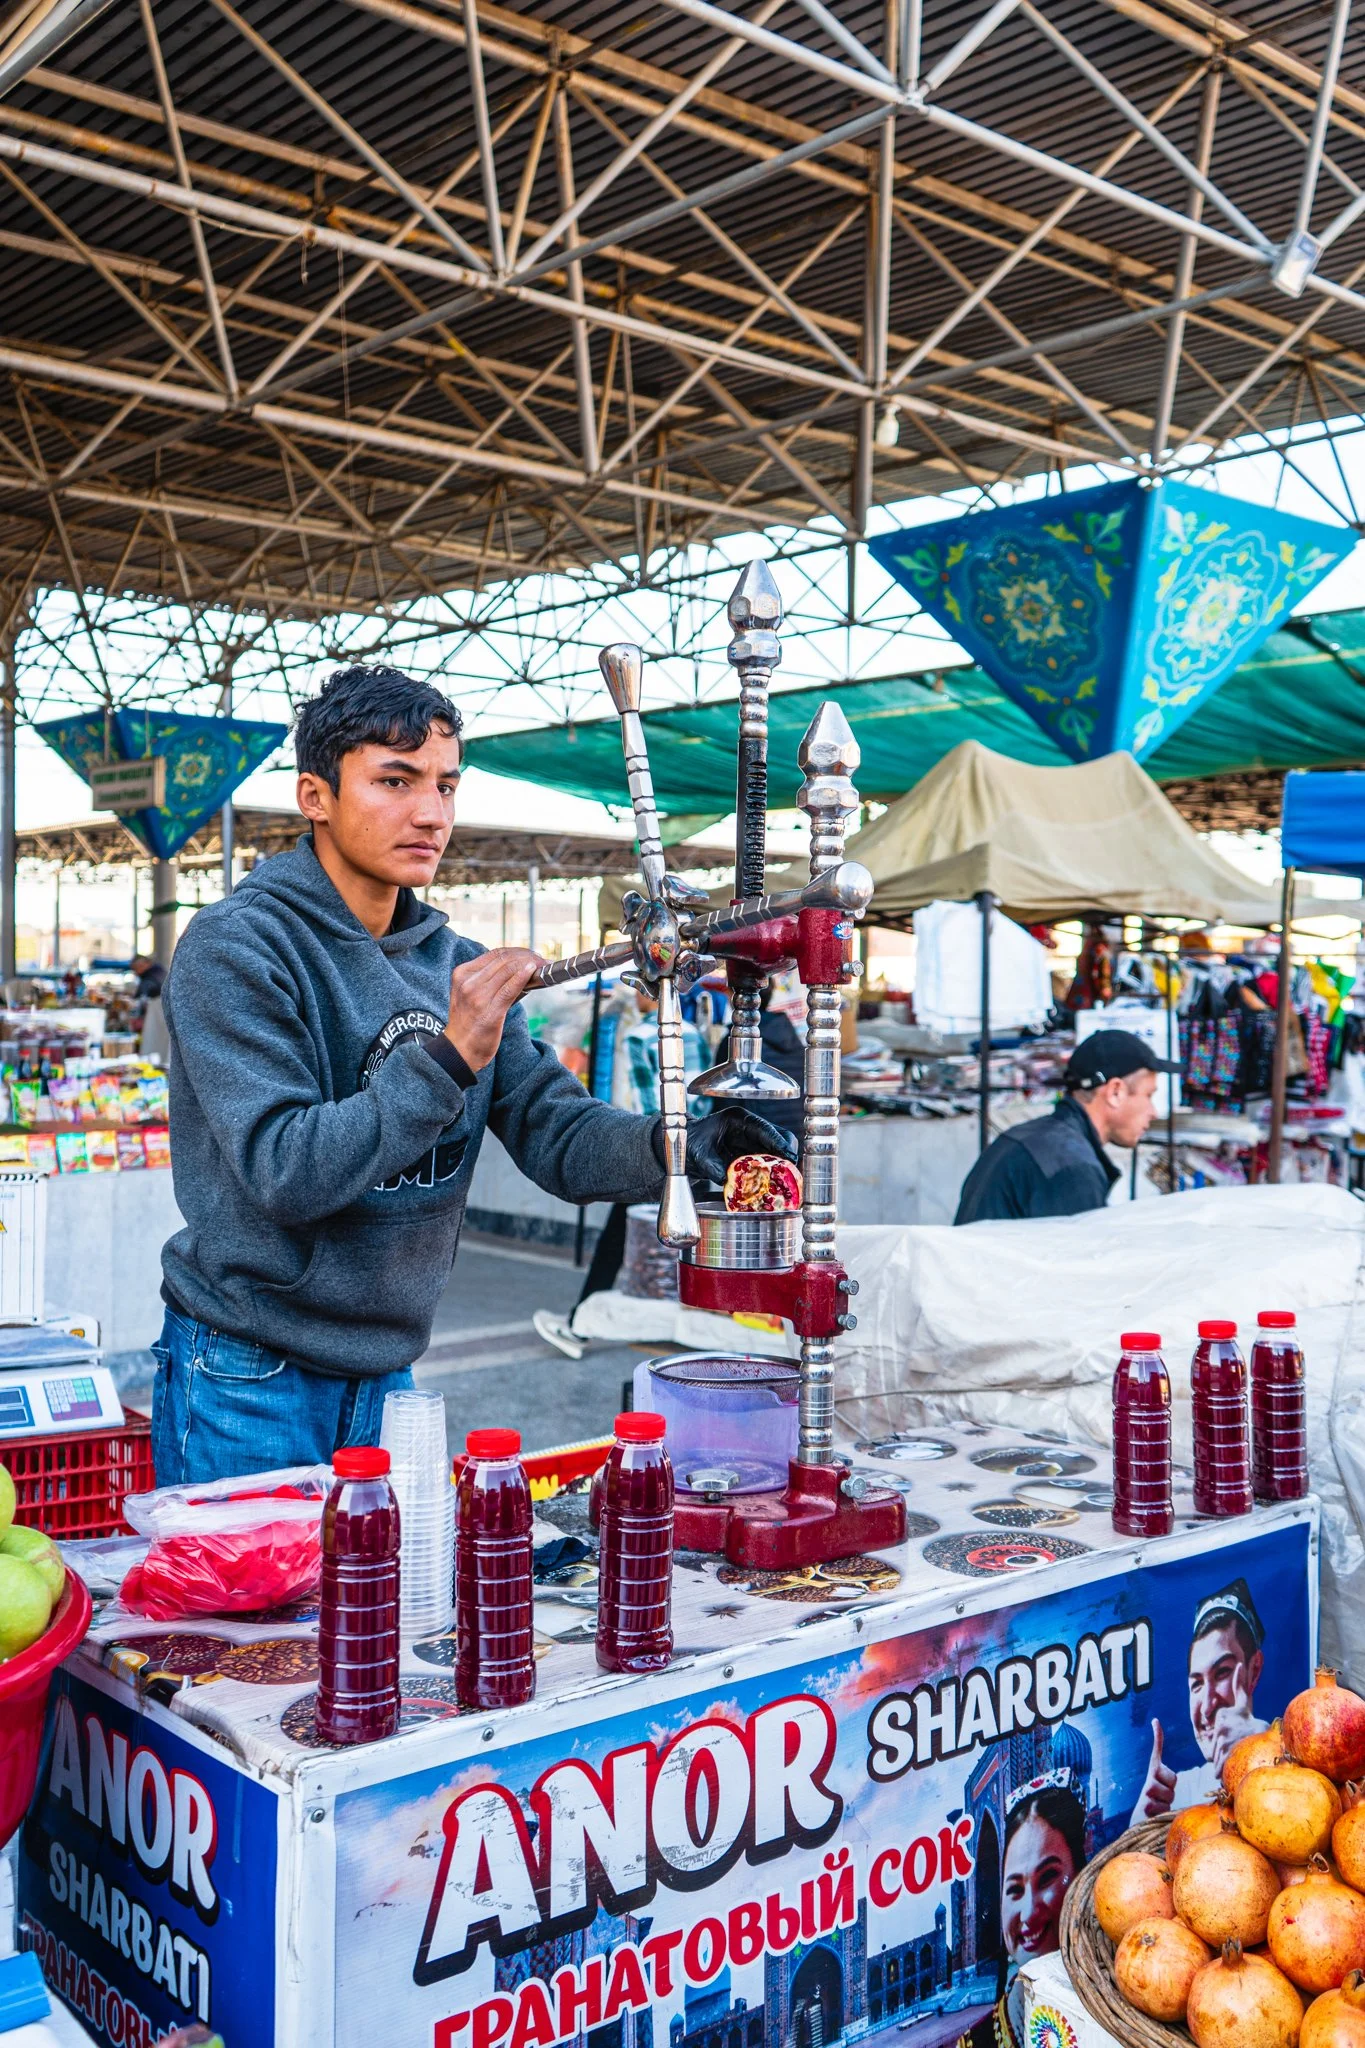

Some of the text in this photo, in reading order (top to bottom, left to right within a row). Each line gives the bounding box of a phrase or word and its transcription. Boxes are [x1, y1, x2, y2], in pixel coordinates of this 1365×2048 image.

[380, 1013, 446, 1049] MERCEDE
[374, 1133, 470, 1191] MG
[50, 1698, 217, 1909] ANOR
[419, 1621, 1152, 1976] ANOR SHARBATI
[49, 1842, 209, 2022] SHARBATI
